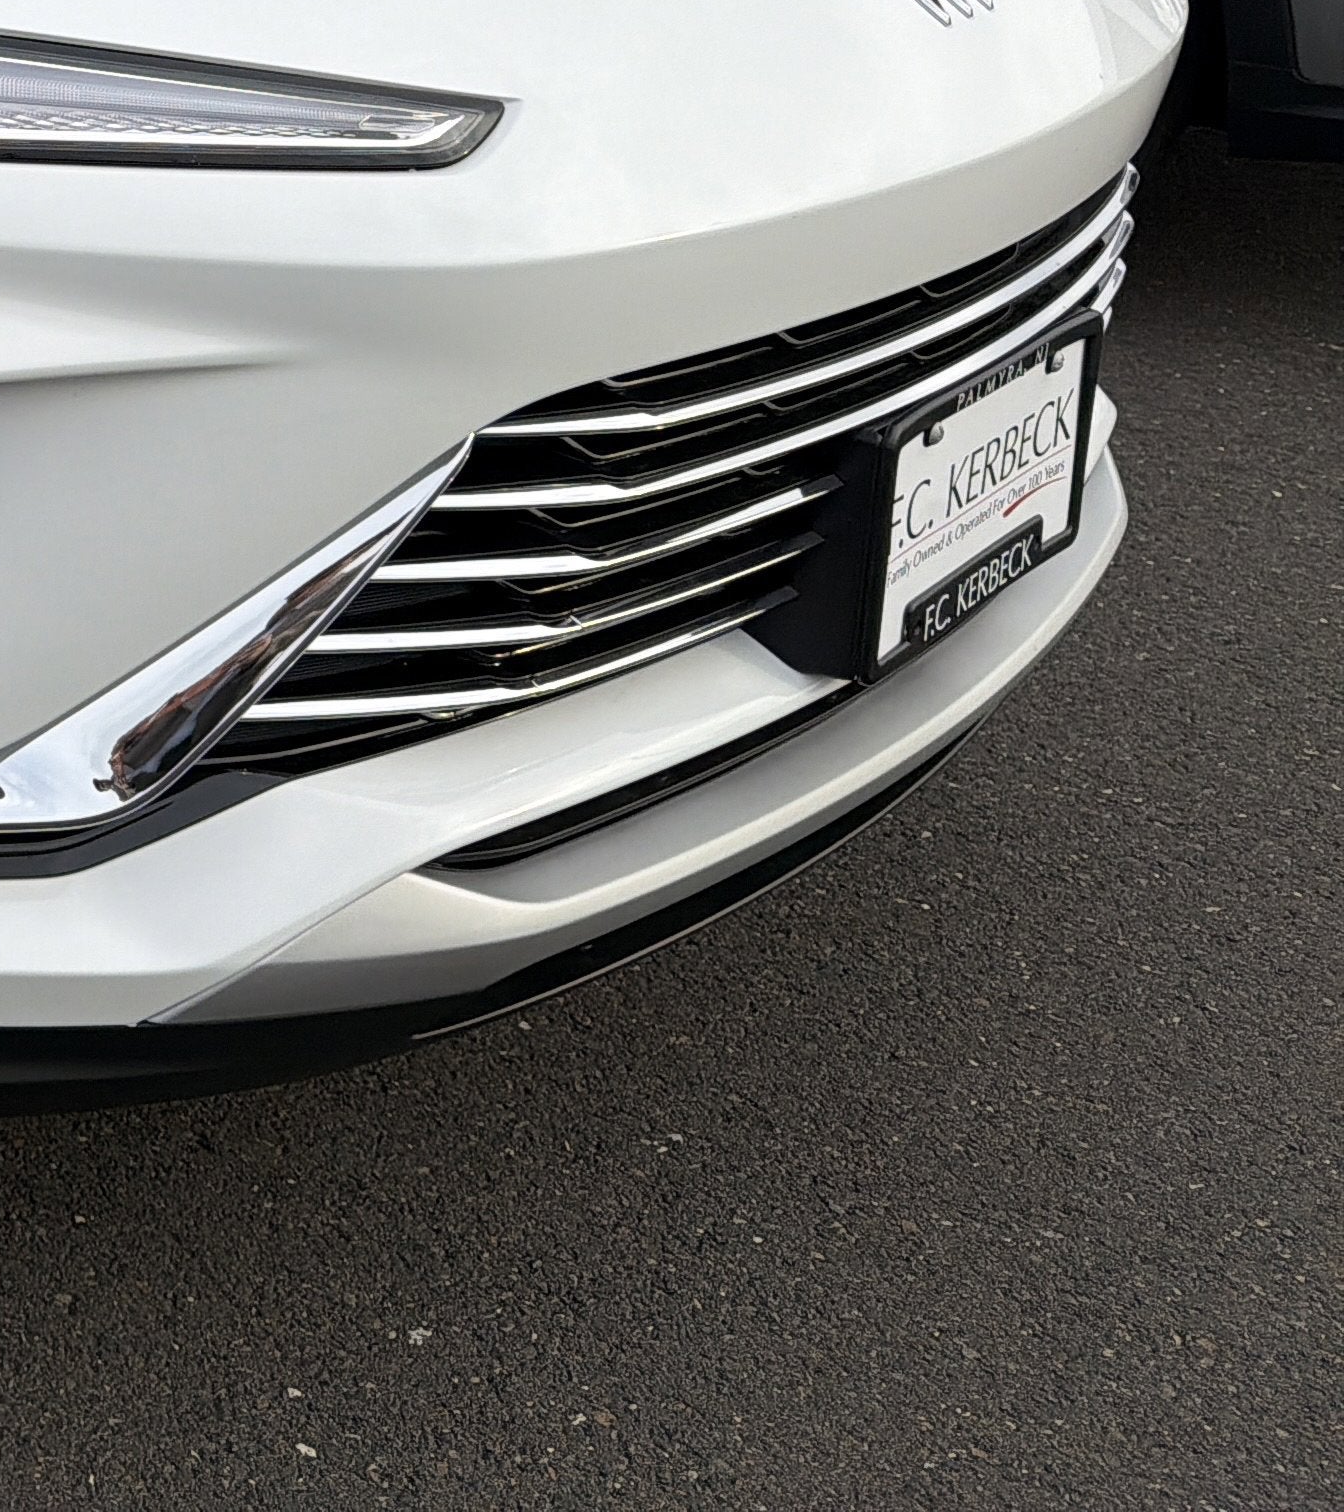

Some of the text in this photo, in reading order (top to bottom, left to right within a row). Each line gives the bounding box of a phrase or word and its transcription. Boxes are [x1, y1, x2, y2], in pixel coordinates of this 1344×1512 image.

[945, 387, 1075, 519] KERBECK
[913, 533, 946, 568] Owned
[955, 501, 993, 541] Operated
[993, 497, 1006, 515] For
[1007, 484, 1027, 504] Over
[1028, 470, 1043, 489] 100
[1044, 460, 1065, 480] Years
[923, 533, 1035, 642] F.C. KERBECK
